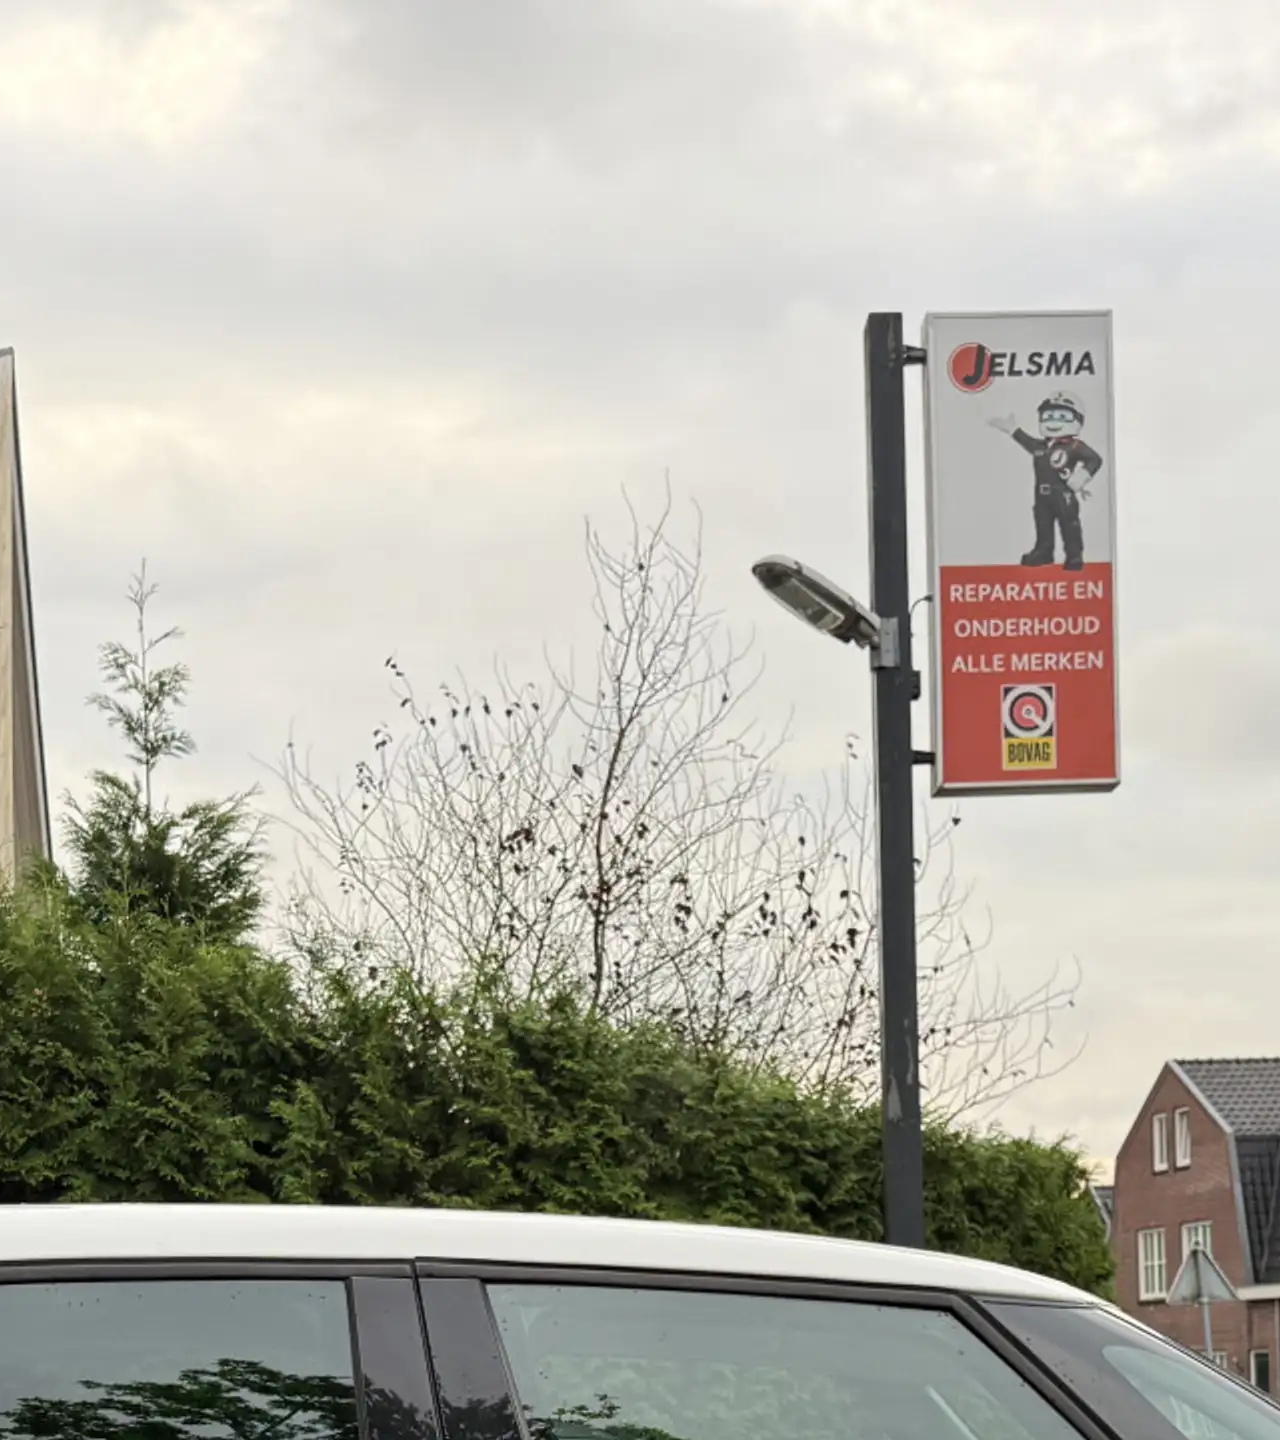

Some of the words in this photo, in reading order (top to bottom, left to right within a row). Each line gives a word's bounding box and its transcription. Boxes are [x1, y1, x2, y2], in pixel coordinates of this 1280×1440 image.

[961, 343, 1096, 386] JELSMA
[949, 582, 1068, 603] REPARATIE
[1073, 580, 1104, 600] EN
[953, 616, 1101, 638] ONDERHOUD
[951, 653, 1006, 674] ALLE
[1010, 650, 1104, 672] MERKEN
[1007, 741, 1051, 763] BOVAG
